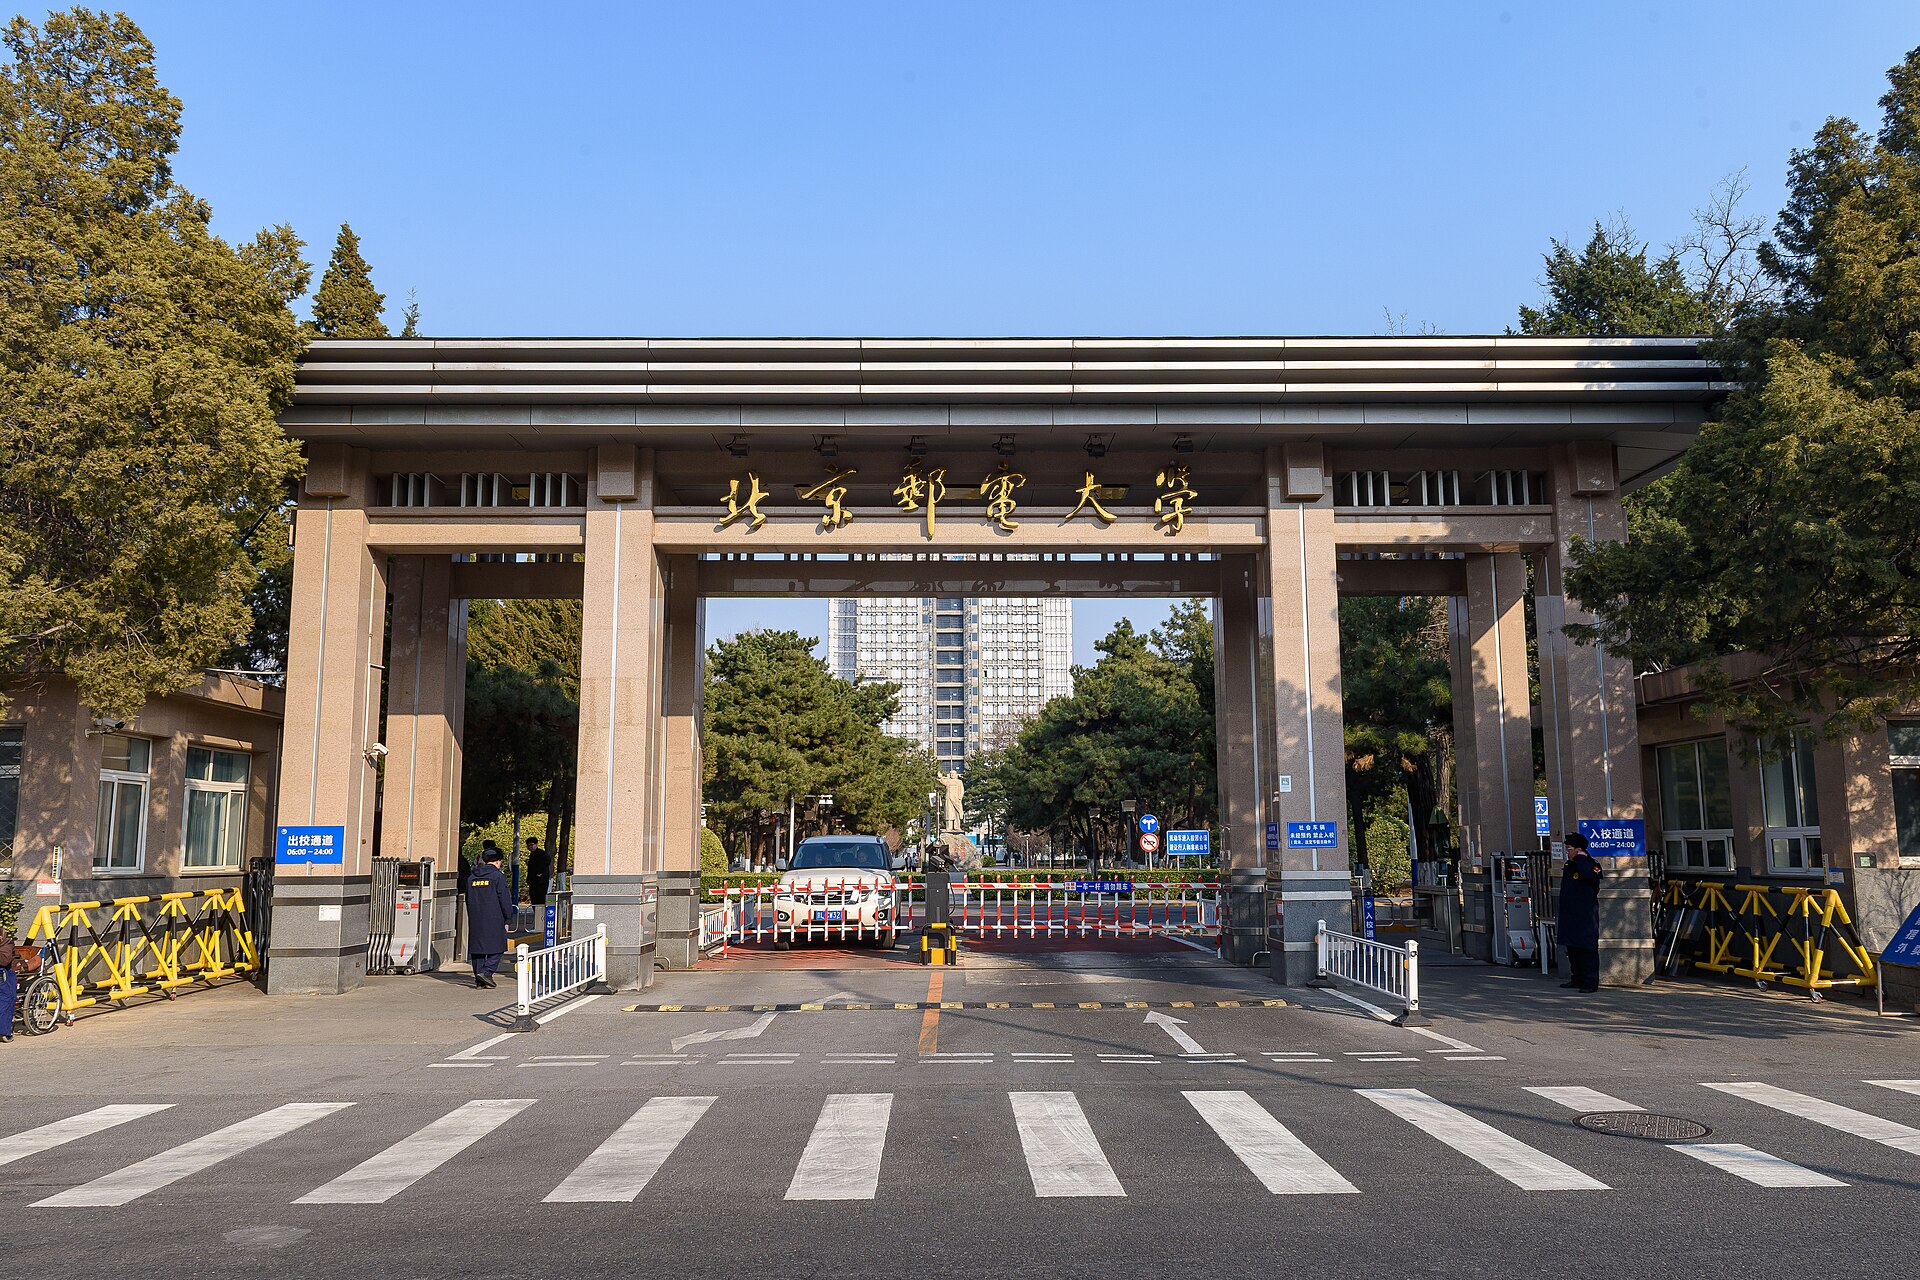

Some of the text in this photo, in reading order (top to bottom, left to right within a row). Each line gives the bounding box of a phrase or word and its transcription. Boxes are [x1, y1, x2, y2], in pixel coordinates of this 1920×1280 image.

[1589, 828, 1634, 839] 入校通道
[287, 834, 333, 846] 出校通道
[1365, 911, 1374, 942] 入校通
